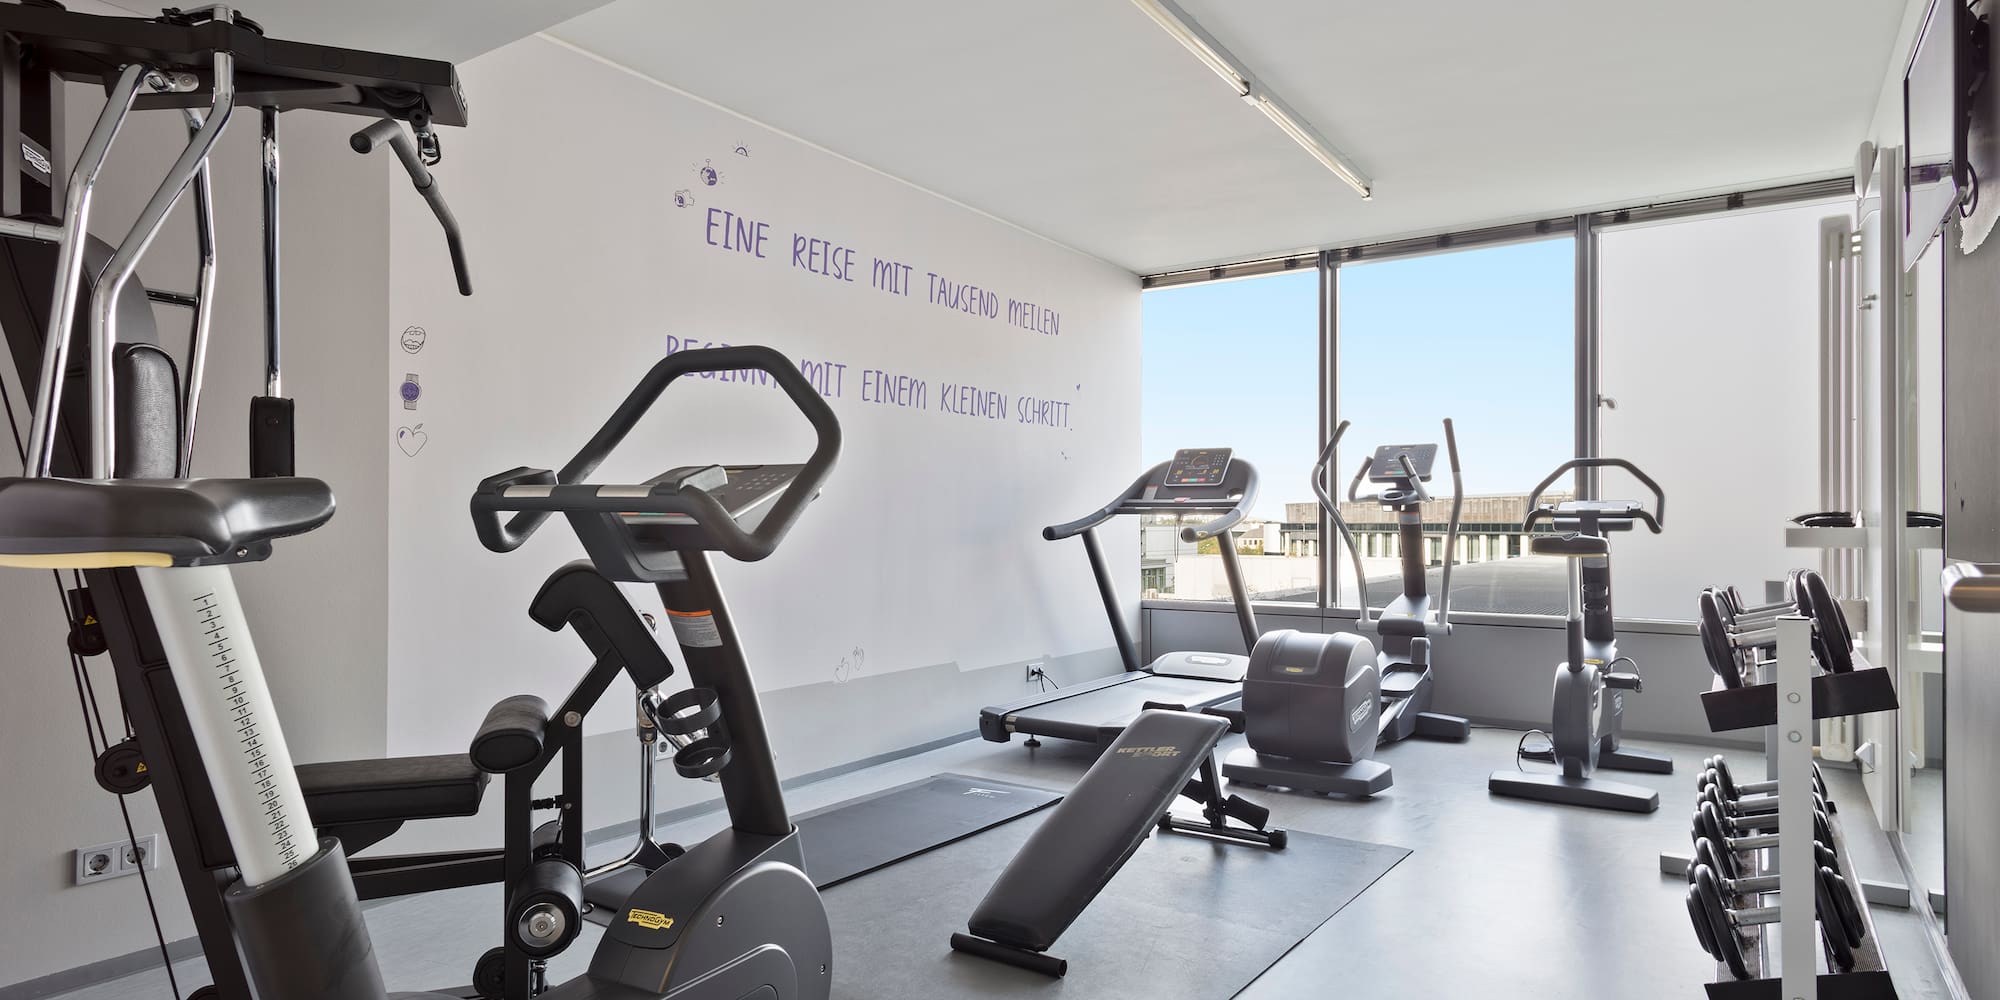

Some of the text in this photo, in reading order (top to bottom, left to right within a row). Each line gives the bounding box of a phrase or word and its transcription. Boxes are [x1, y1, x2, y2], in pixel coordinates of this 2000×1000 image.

[706, 207, 1060, 336] EINE REISE MIT TAUSEND MEILEN
[862, 369, 927, 410] EINEM
[940, 382, 1007, 420] KLEINEN
[1017, 396, 1073, 431] SCHRITT.
[210, 621, 216, 629] 3
[217, 643, 224, 651] 5
[232, 686, 238, 694] 9
[233, 696, 244, 705] 10
[238, 707, 247, 715] 11
[240, 718, 251, 727] 12
[243, 728, 255, 737] 13
[247, 739, 258, 747] 14
[251, 749, 261, 758] 15
[254, 760, 264, 768] 16
[258, 770, 267, 778] 17
[261, 780, 271, 789] 18
[265, 790, 274, 799] 19
[268, 800, 278, 810] 20
[271, 810, 281, 820] 21
[274, 820, 285, 830] 22
[278, 830, 288, 840] 23
[281, 840, 291, 850] 24
[284, 850, 294, 860] 25
[287, 860, 298, 870] 26
